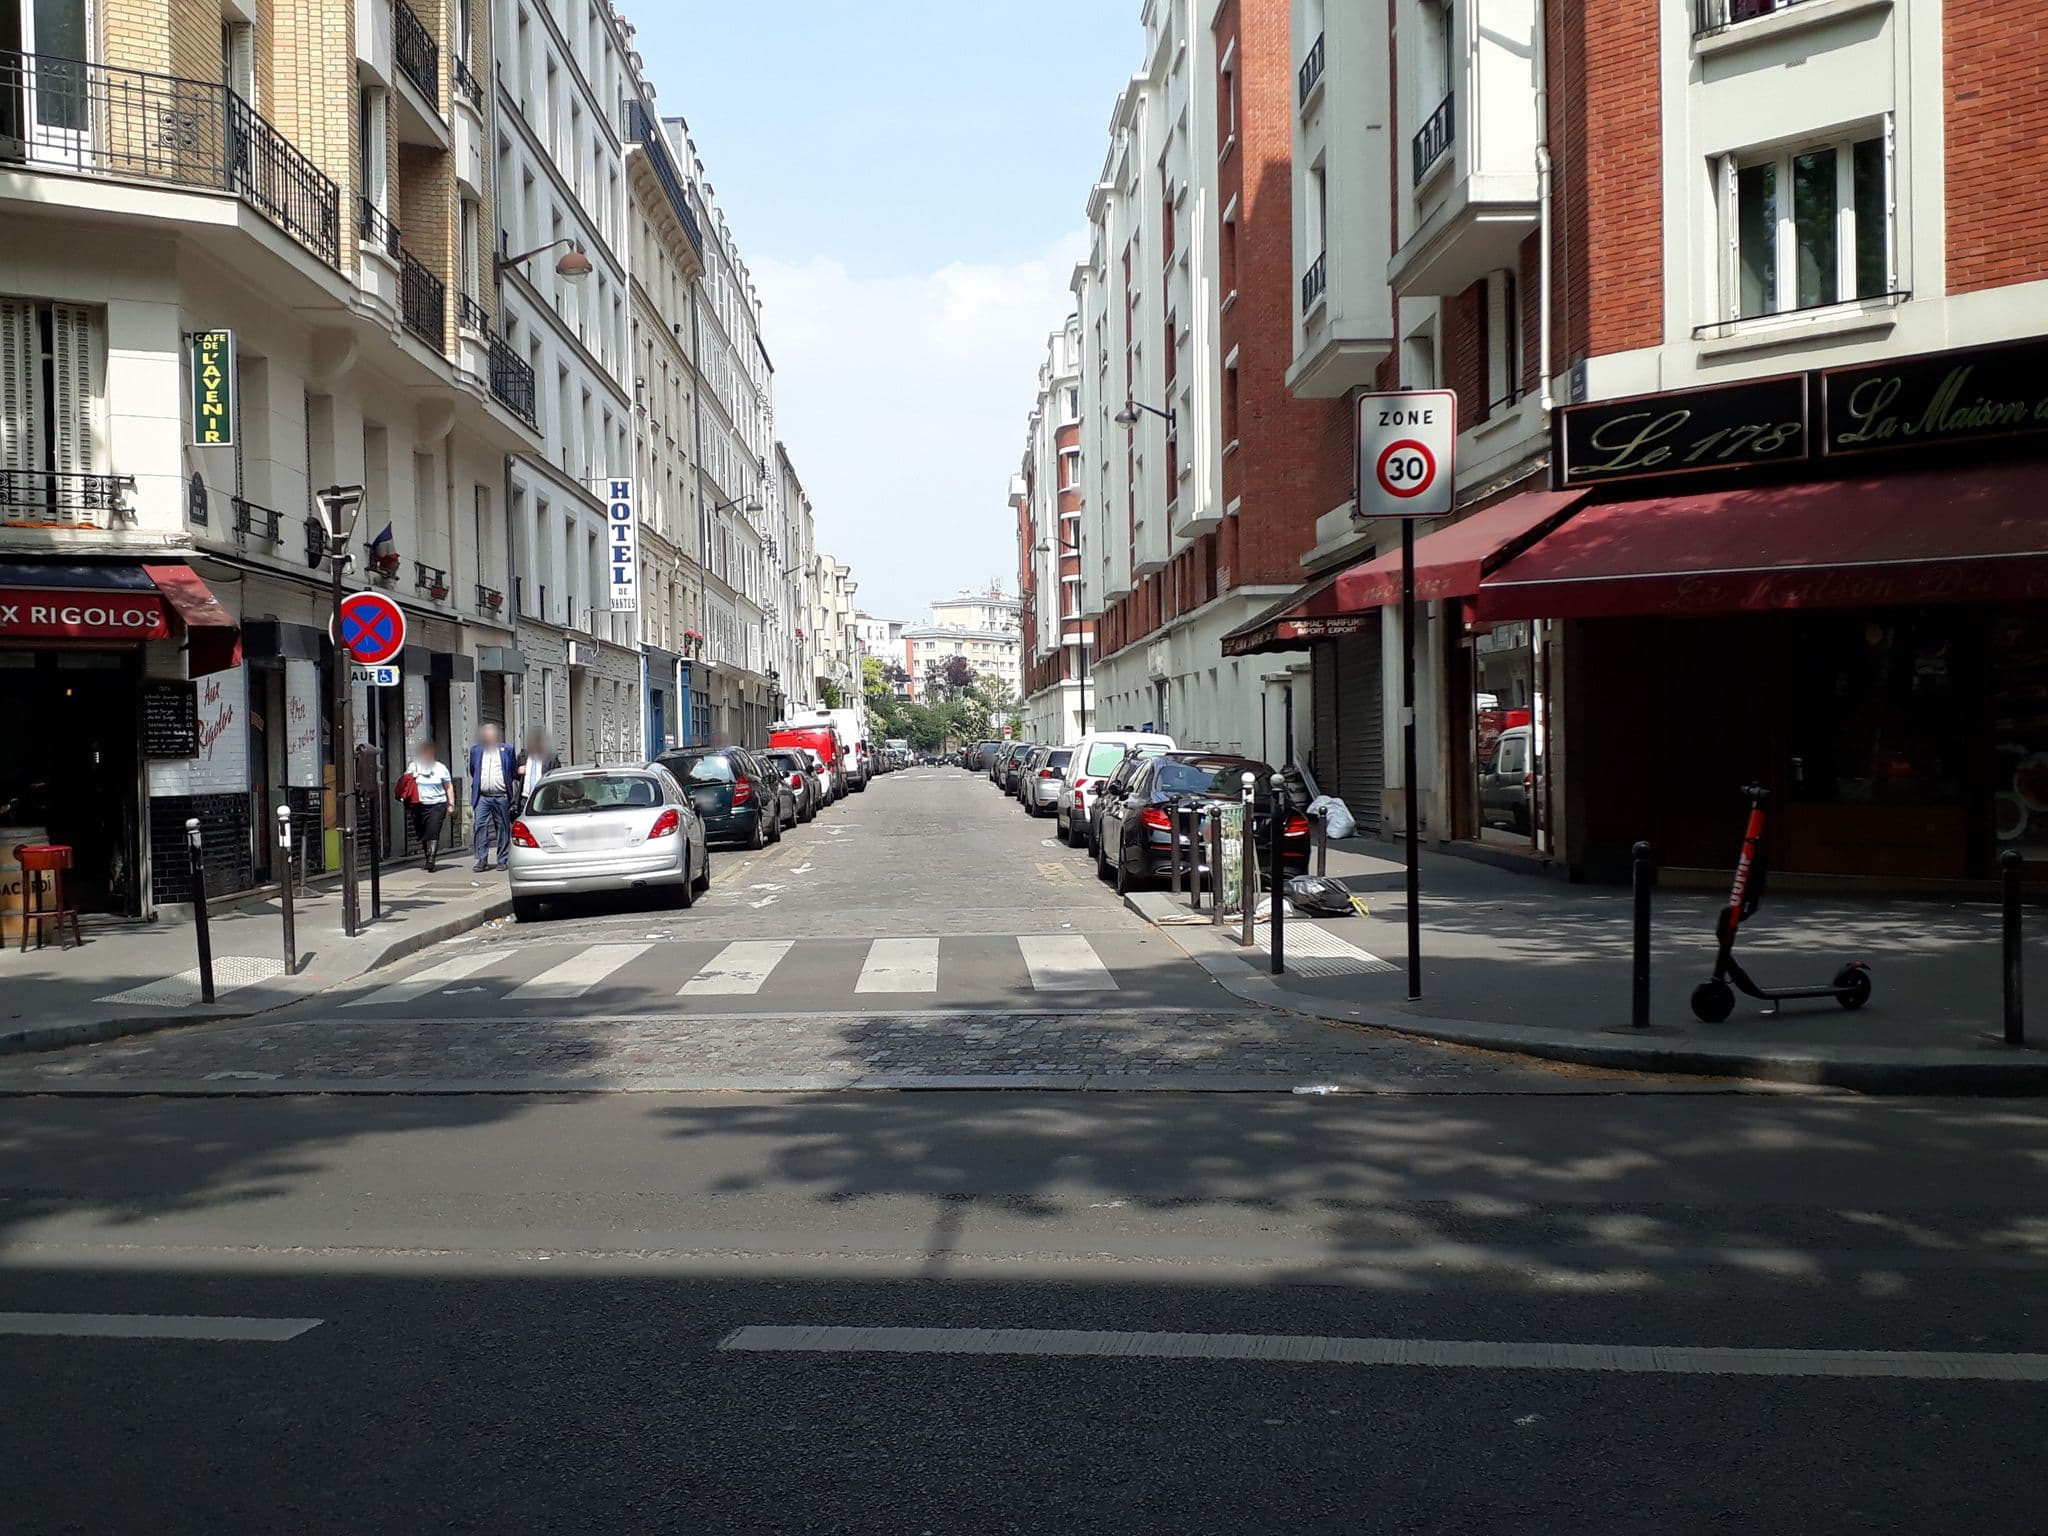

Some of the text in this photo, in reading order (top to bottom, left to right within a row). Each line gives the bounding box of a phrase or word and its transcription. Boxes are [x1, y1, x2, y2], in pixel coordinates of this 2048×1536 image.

[203, 342, 219, 350] DE
[202, 352, 223, 443] L'AVENIR
[1836, 364, 2027, 444] La Maison
[1379, 410, 1434, 427] ZONE
[1568, 409, 1802, 475] Le 178
[1389, 456, 1424, 481] 30
[610, 481, 633, 585] HOTEL
[618, 587, 628, 596] DE
[31, 606, 161, 628] RIGOLOS
[352, 671, 375, 682] AUF
